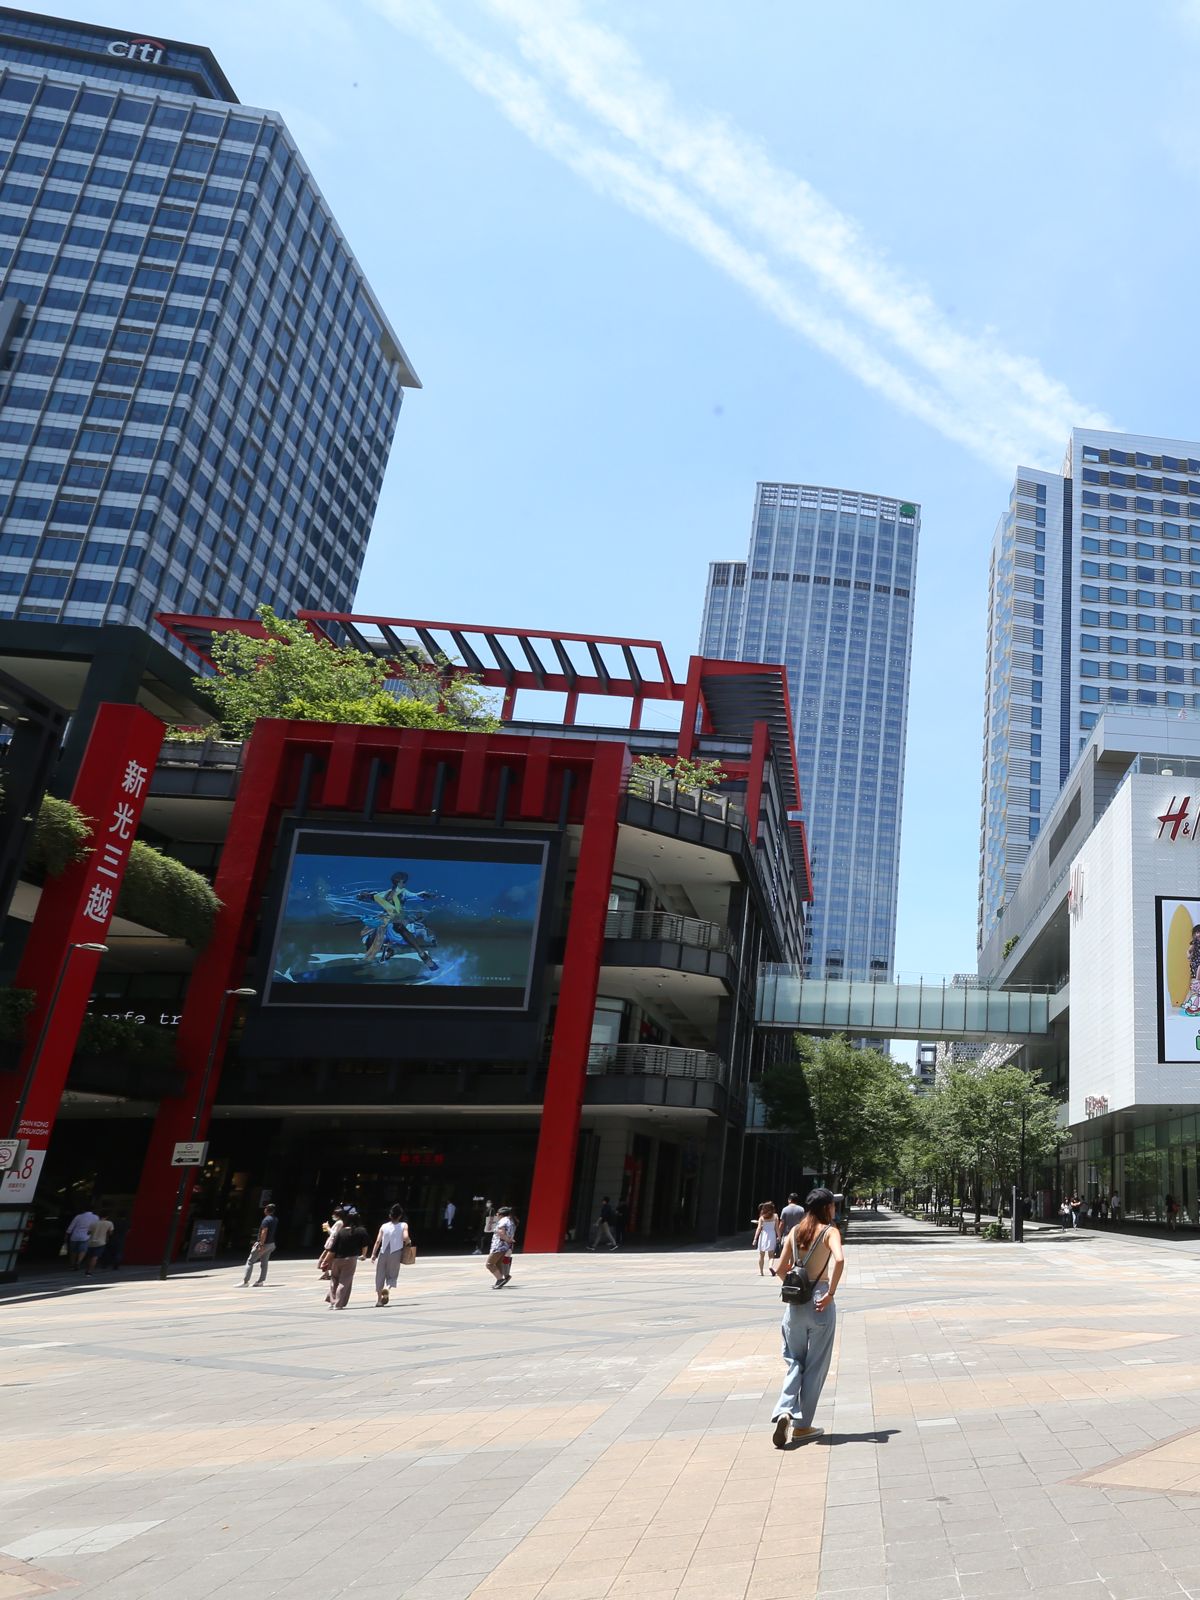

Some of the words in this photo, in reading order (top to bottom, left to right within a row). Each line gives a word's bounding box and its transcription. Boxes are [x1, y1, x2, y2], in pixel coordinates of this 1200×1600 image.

[107, 39, 165, 64] citi
[83, 759, 147, 923] 新光三越
